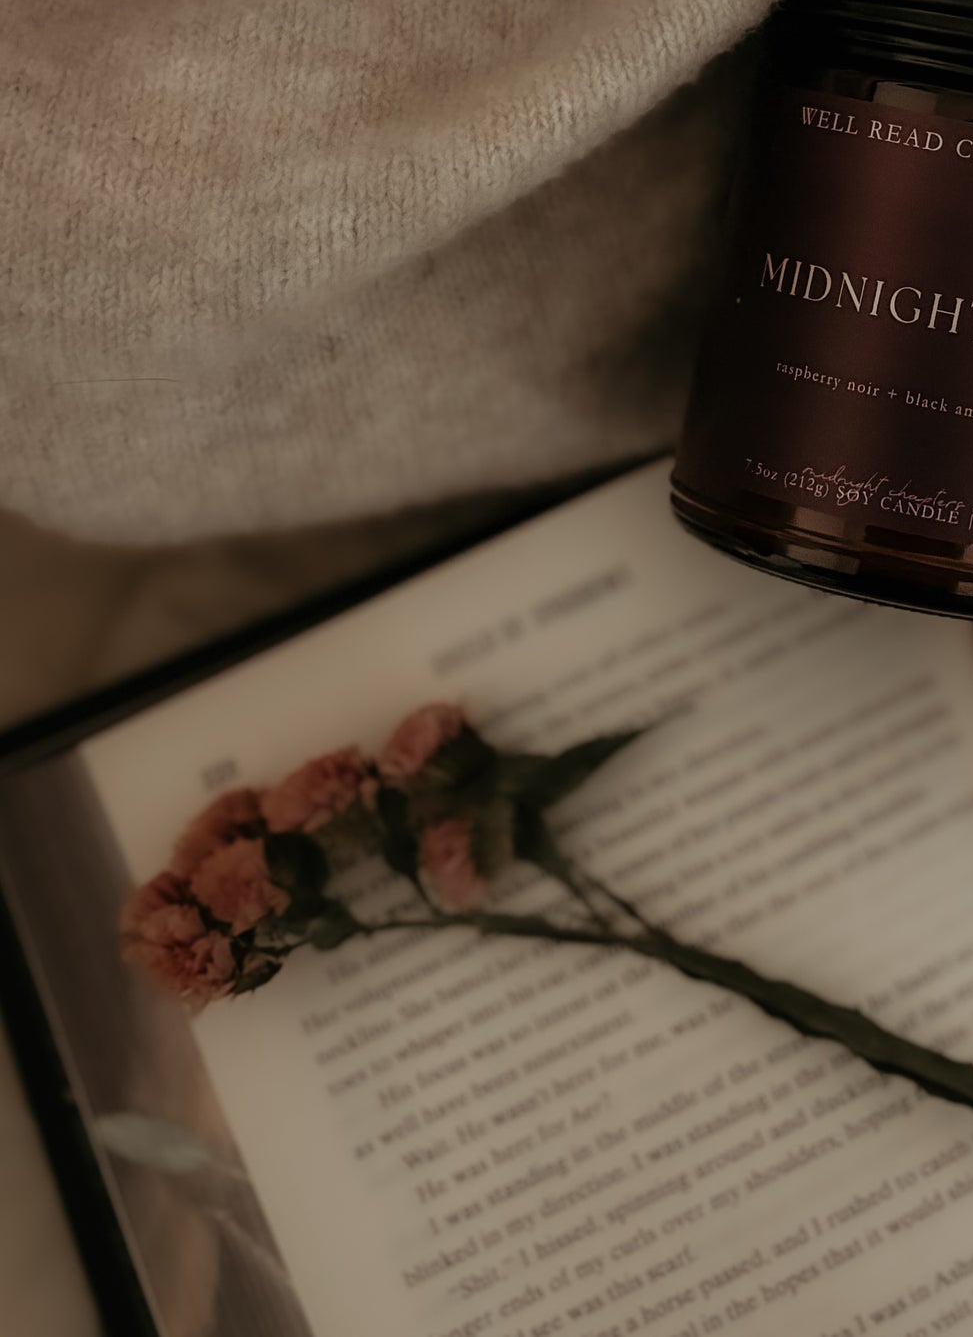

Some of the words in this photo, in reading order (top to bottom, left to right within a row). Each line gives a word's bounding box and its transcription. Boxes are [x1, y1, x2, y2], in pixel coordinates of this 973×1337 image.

[803, 106, 858, 134] WELL
[868, 120, 943, 151] READ
[777, 363, 840, 390] raspberry
[847, 382, 880, 398] noir
[906, 391, 947, 412] black
[784, 472, 829, 498] (212g)
[836, 485, 873, 505] SOY
[880, 496, 960, 525] CANDLE
